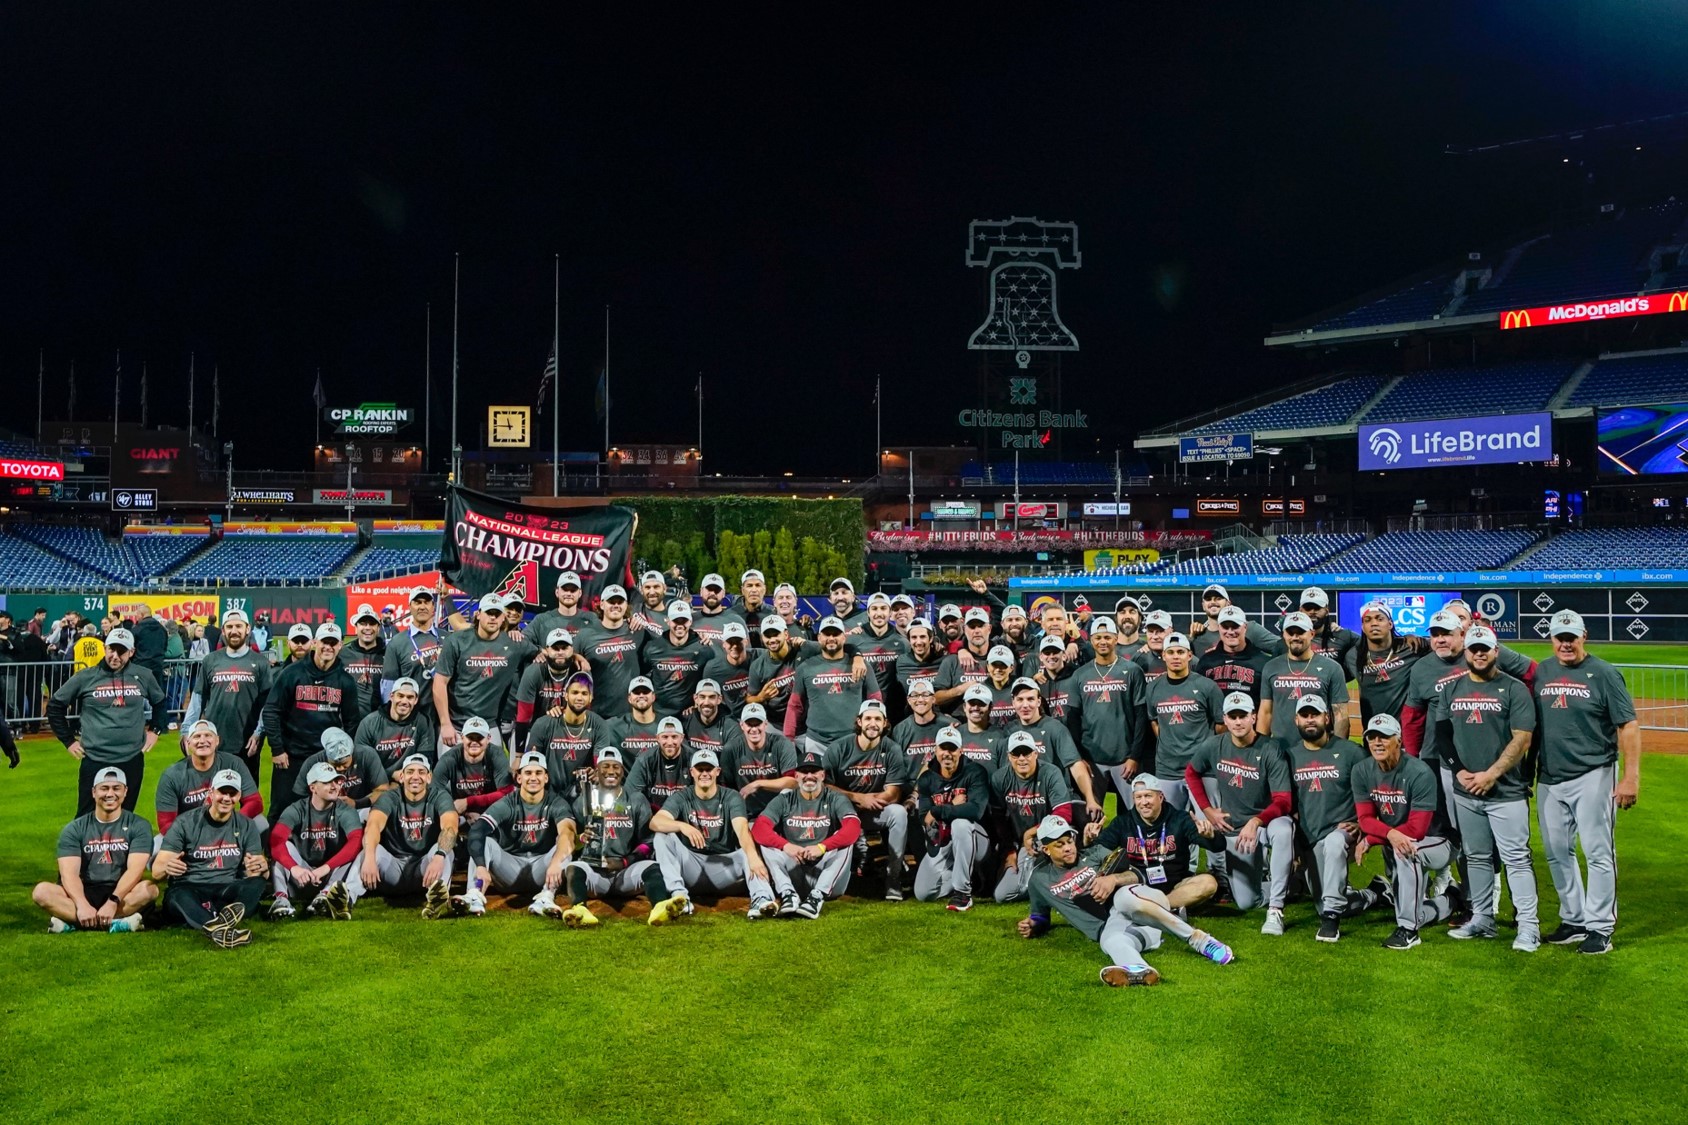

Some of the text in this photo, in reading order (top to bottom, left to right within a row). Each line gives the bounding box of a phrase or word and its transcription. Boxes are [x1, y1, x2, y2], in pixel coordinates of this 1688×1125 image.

[1548, 298, 1650, 320] McDonald's
[331, 409, 408, 421] CP RANKIN
[958, 409, 1088, 428] Citizens Bank
[345, 425, 393, 433] ROOFTOP
[1002, 430, 1044, 448] Park
[1411, 424, 1541, 455] LifeBrand
[130, 448, 180, 459] GIANT
[1, 463, 60, 477] TOYOTA
[504, 511, 569, 531] 20 23
[468, 513, 602, 546] NATIONAL LEAGUE
[454, 521, 612, 573] CHAMPIONS
[1117, 554, 1150, 562] PLAY
[1391, 574, 1436, 582] Independence
[1479, 573, 1508, 581] ibx.com
[1543, 571, 1593, 581] Independence
[1641, 571, 1673, 580] ibx.com
[372, 586, 389, 595] good
[390, 586, 411, 595] neighb
[84, 597, 104, 610] 374
[226, 598, 246, 610] 387
[1486, 602, 1496, 612] R
[595, 643, 636, 654] CHAMPIONS
[465, 659, 508, 667] CHAMPIONS
[656, 663, 699, 672] CHAMPIONS
[345, 666, 382, 674] CHAMPION
[212, 675, 256, 683] CHAMPIONS
[812, 676, 853, 685] CHAMPION
[960, 675, 988, 683] CHAMP
[1273, 679, 1321, 689] CHAMPIONS
[722, 680, 749, 691] CHAMPI
[1083, 683, 1127, 692] CHAMPIONS
[92, 689, 142, 698] CHAMPIONS
[1540, 687, 1591, 699] CHAMPIONS
[1156, 704, 1199, 713] CHAMPIONS
[1450, 702, 1502, 712] CHAMPIONS
[376, 739, 415, 751] CHAMPIONS
[550, 742, 592, 750] CHAMPIONS
[738, 766, 777, 776] CHAMPIONS
[844, 766, 887, 776] CHAMPIONS
[1216, 763, 1260, 780] CHAMPIONS
[1293, 769, 1339, 780] CHAMPIONS
[786, 818, 831, 828] CHAMPIONS
[83, 842, 129, 853] CHAMPIONS
[193, 848, 241, 859] CHAMPIONS
